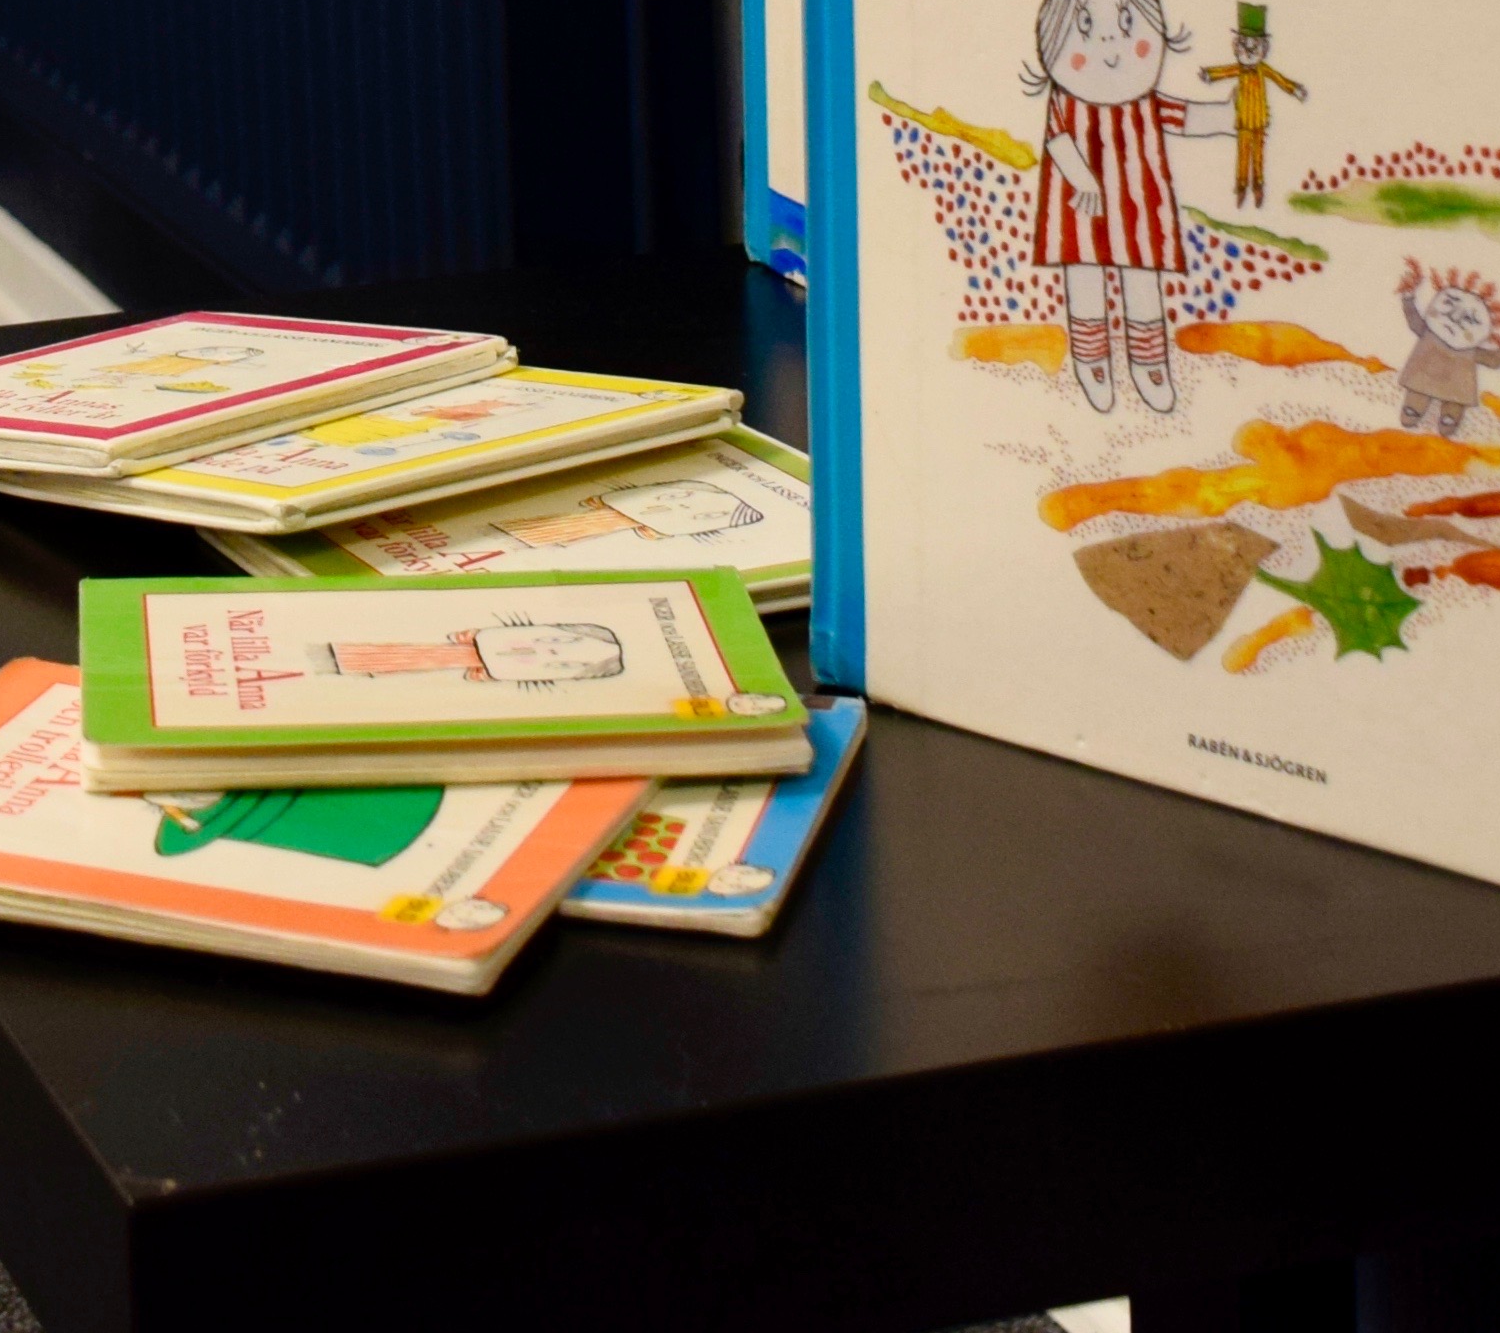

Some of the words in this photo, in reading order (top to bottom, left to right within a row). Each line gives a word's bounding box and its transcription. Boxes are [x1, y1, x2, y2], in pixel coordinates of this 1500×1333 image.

[183, 624, 210, 646] var
[227, 609, 264, 633] När
[230, 635, 272, 663] lilla
[178, 648, 229, 698] förkyld
[235, 665, 305, 711] Anna
